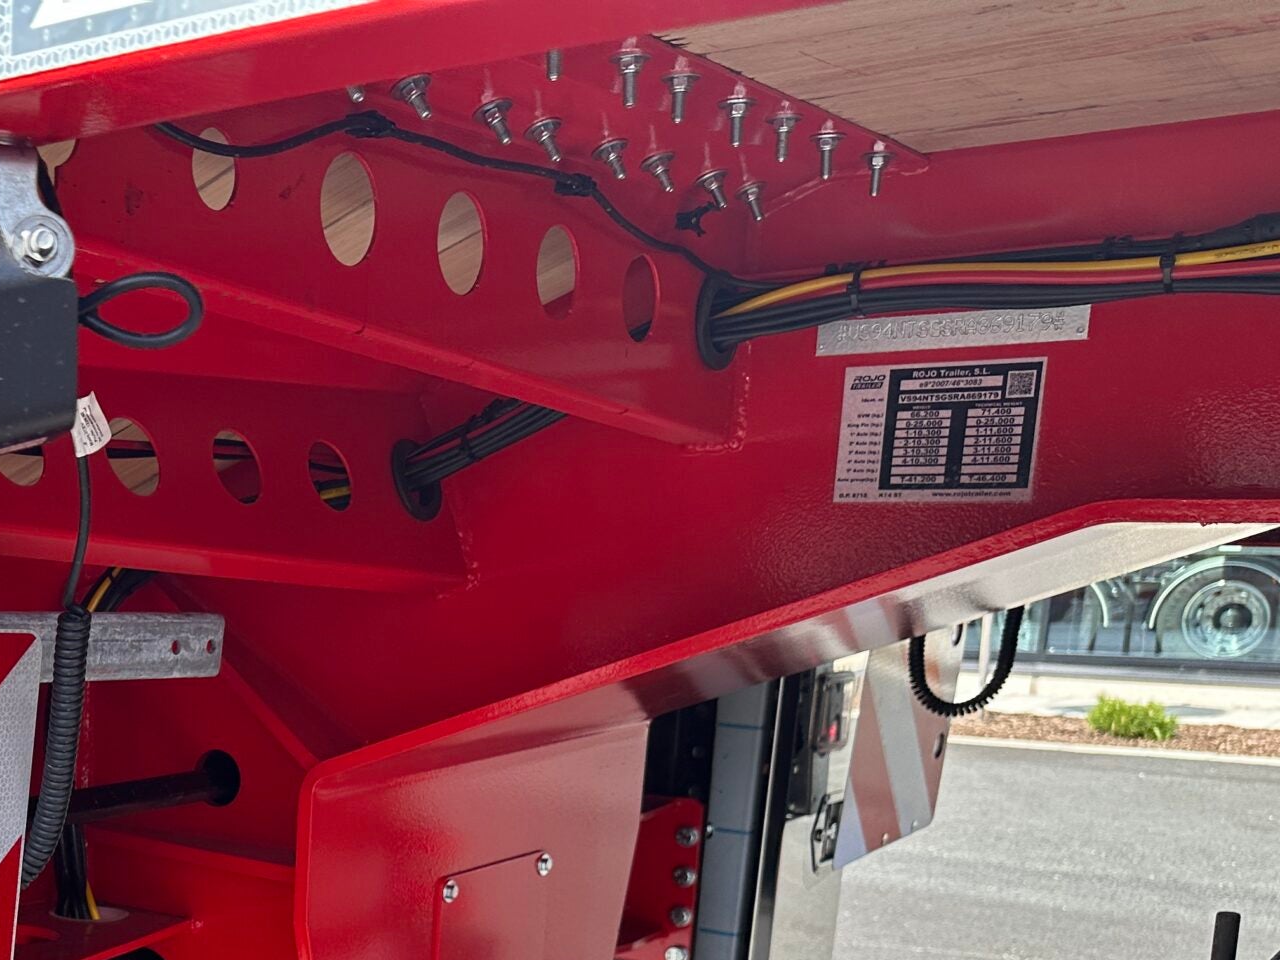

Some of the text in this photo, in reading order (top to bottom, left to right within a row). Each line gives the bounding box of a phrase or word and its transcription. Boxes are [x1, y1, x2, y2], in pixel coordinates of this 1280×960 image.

[912, 367, 991, 379] ROJO Trailer, S.L.
[853, 374, 886, 382] ROJO
[899, 391, 1000, 403] VS94NTSGSRA869179
[980, 408, 1012, 416] 71.400
[905, 419, 943, 427] 0-25.000
[976, 417, 1015, 425] 0-25.000
[904, 429, 942, 437] 1-10.300
[975, 427, 1014, 435] 1-11.600
[903, 438, 941, 446] 2-10.300
[902, 447, 940, 455] 3-10.300
[972, 446, 1012, 454] 3-11.600
[901, 456, 939, 464] 4-10.300
[971, 455, 1011, 463] 4-11.600
[931, 490, 1012, 498] www.rojotrailer.com
